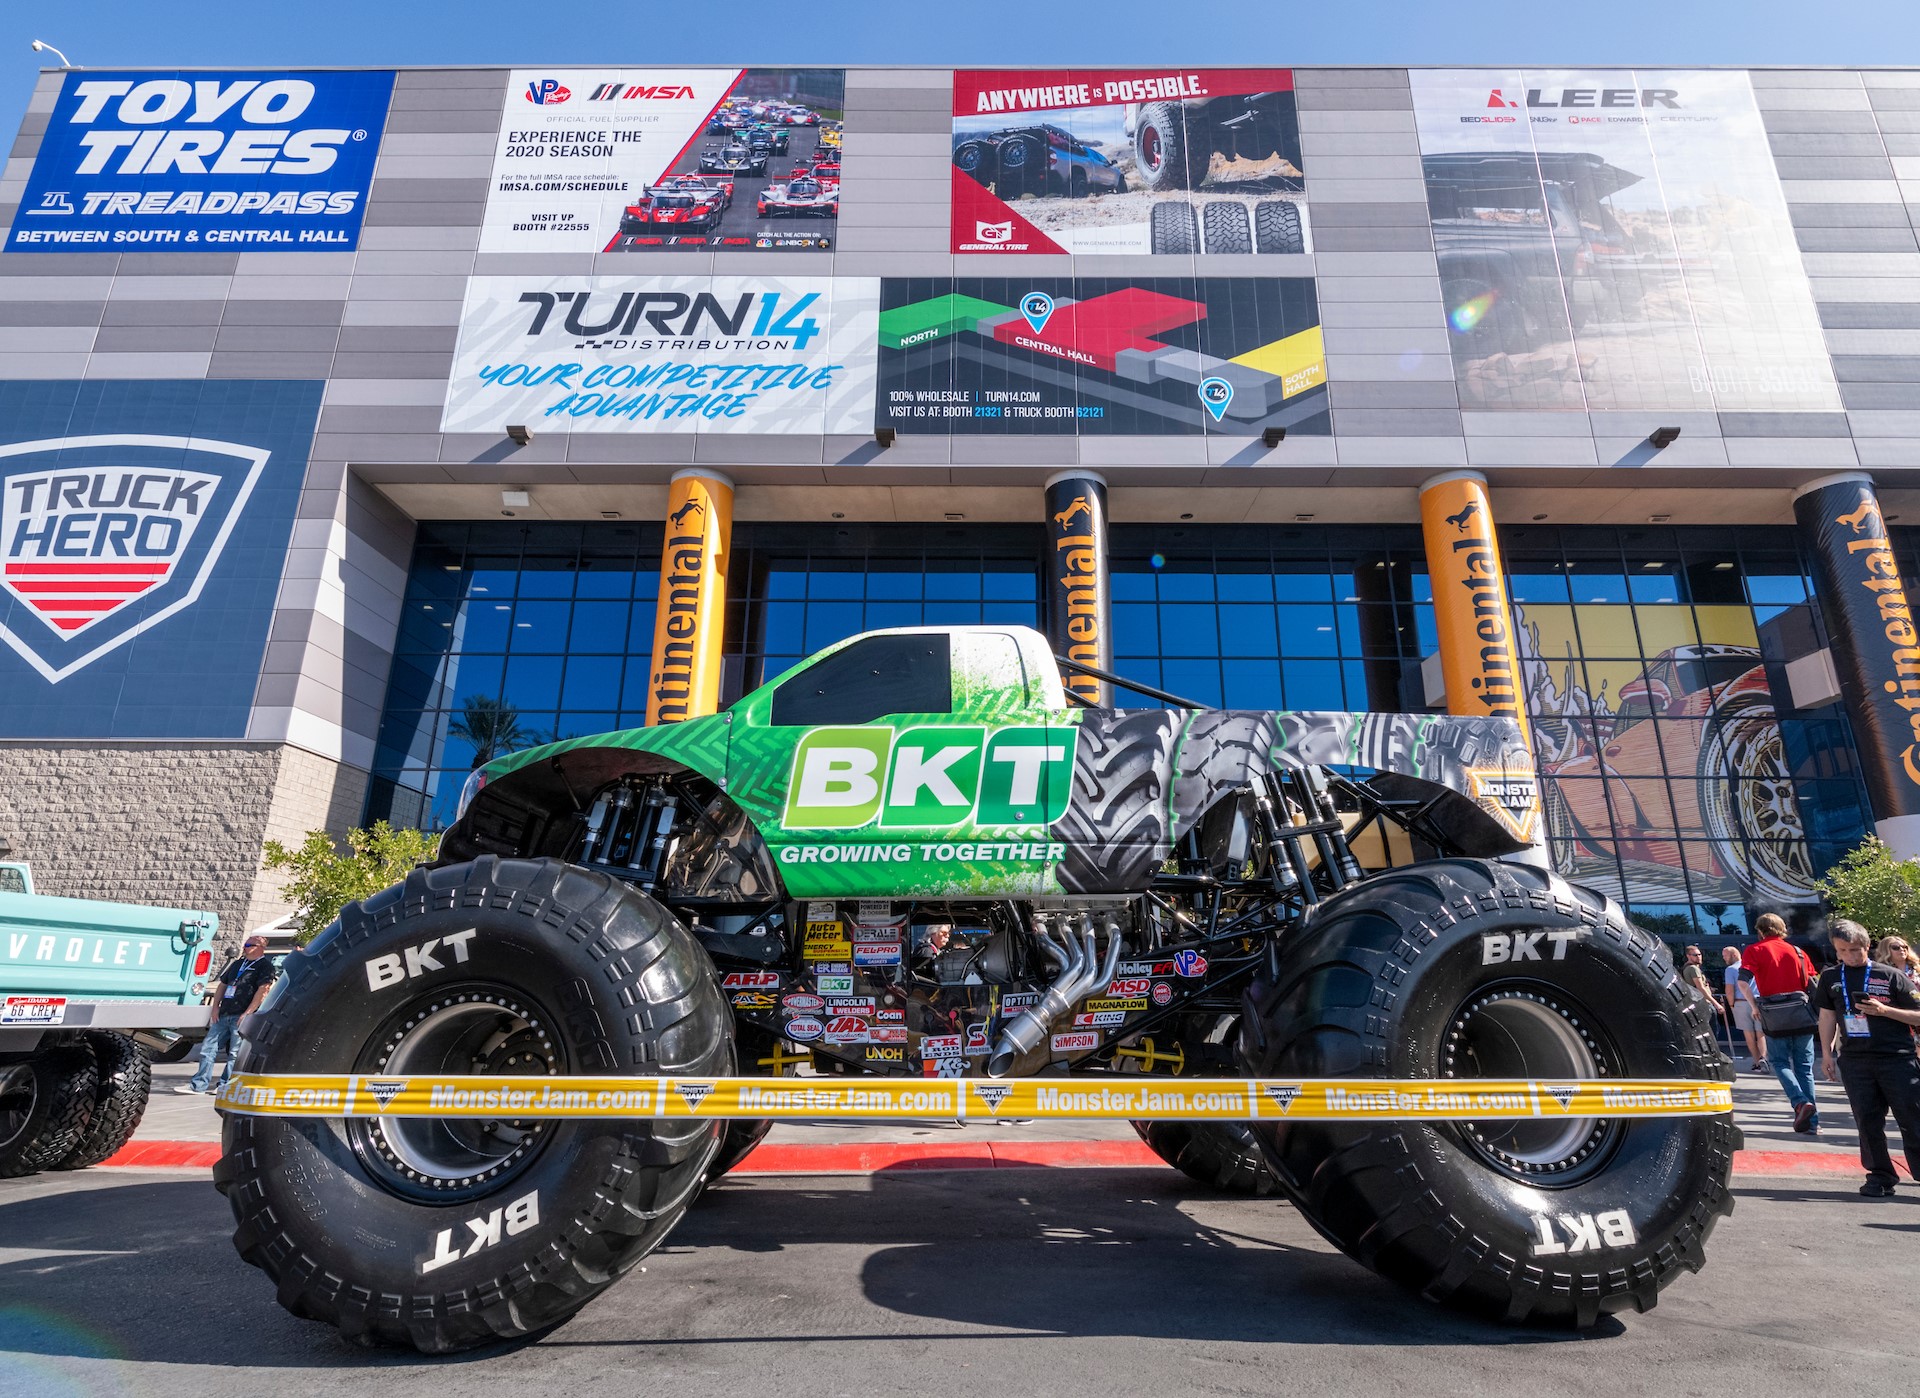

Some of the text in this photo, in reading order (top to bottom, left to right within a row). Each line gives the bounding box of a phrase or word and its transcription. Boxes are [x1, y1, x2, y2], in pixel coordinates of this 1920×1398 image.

[528, 79, 559, 106] VP
[622, 86, 695, 100] IMSA
[977, 75, 1209, 112] ANYWHERE IS POSSIBLE.
[1527, 89, 1682, 109] LEER
[69, 80, 315, 124] TOYO
[508, 131, 642, 143] EXPERIENCE THE
[506, 145, 613, 157] 2020 SEASON
[499, 182, 628, 191] IMSA.COM/SCHEDULE
[81, 191, 359, 215] TREADPASS
[513, 223, 590, 231] BOOTH #22555
[16, 230, 349, 243] BETWEEN SOUTH & CENTRAL HALL
[900, 328, 939, 347] NORTH
[613, 340, 788, 350] DISTRIBUTION
[1014, 335, 1097, 365] CENTRAL HALL
[478, 361, 844, 391] YOUR COMPETITIVE
[1285, 365, 1320, 387] SOUTH
[1285, 380, 1313, 398] HALL
[889, 391, 1041, 402] 100% WHOLESALE TURN14.COM
[544, 393, 758, 421] ADVANTAGE
[889, 407, 1104, 417] VISIT US AT: BOOTH 21321 & TRUCK BOOTH 62121
[12, 474, 212, 516] TRUCK
[9, 513, 183, 557] HERO
[796, 745, 1066, 807] BKT
[1500, 796, 1531, 807] JAM
[780, 843, 1065, 863] GROWING TOGETHER
[810, 923, 836, 932] Auto
[856, 929, 896, 938] DERALE
[806, 931, 840, 941] Meter
[9, 933, 152, 966] VROLET
[1481, 931, 1577, 965] BKT
[365, 927, 476, 992] BKT
[1174, 950, 1197, 977] VP
[1119, 964, 1152, 976] Holley
[724, 974, 777, 985] ARP
[821, 979, 851, 990] BKT
[1109, 980, 1150, 993] MSD
[1005, 996, 1040, 1006] OPTIMA
[1088, 1001, 1145, 1009] MAGNAFLOW
[31, 1004, 57, 1016] CREW
[876, 1011, 902, 1020] Coan
[1095, 1013, 1123, 1021] KING
[826, 1018, 867, 1032] JAZ
[928, 1037, 959, 1046] FK
[1055, 1035, 1094, 1047] SIMPSON
[866, 1047, 903, 1059] UNOH
[429, 1084, 650, 1110] MonsterJam.com
[738, 1087, 951, 1111] MonsterJam.com
[1036, 1087, 1244, 1111] MonsterJam.com
[1325, 1088, 1526, 1112] MonsterJam.com
[422, 1189, 540, 1274] BKT
[1533, 1209, 1636, 1256] BKT
